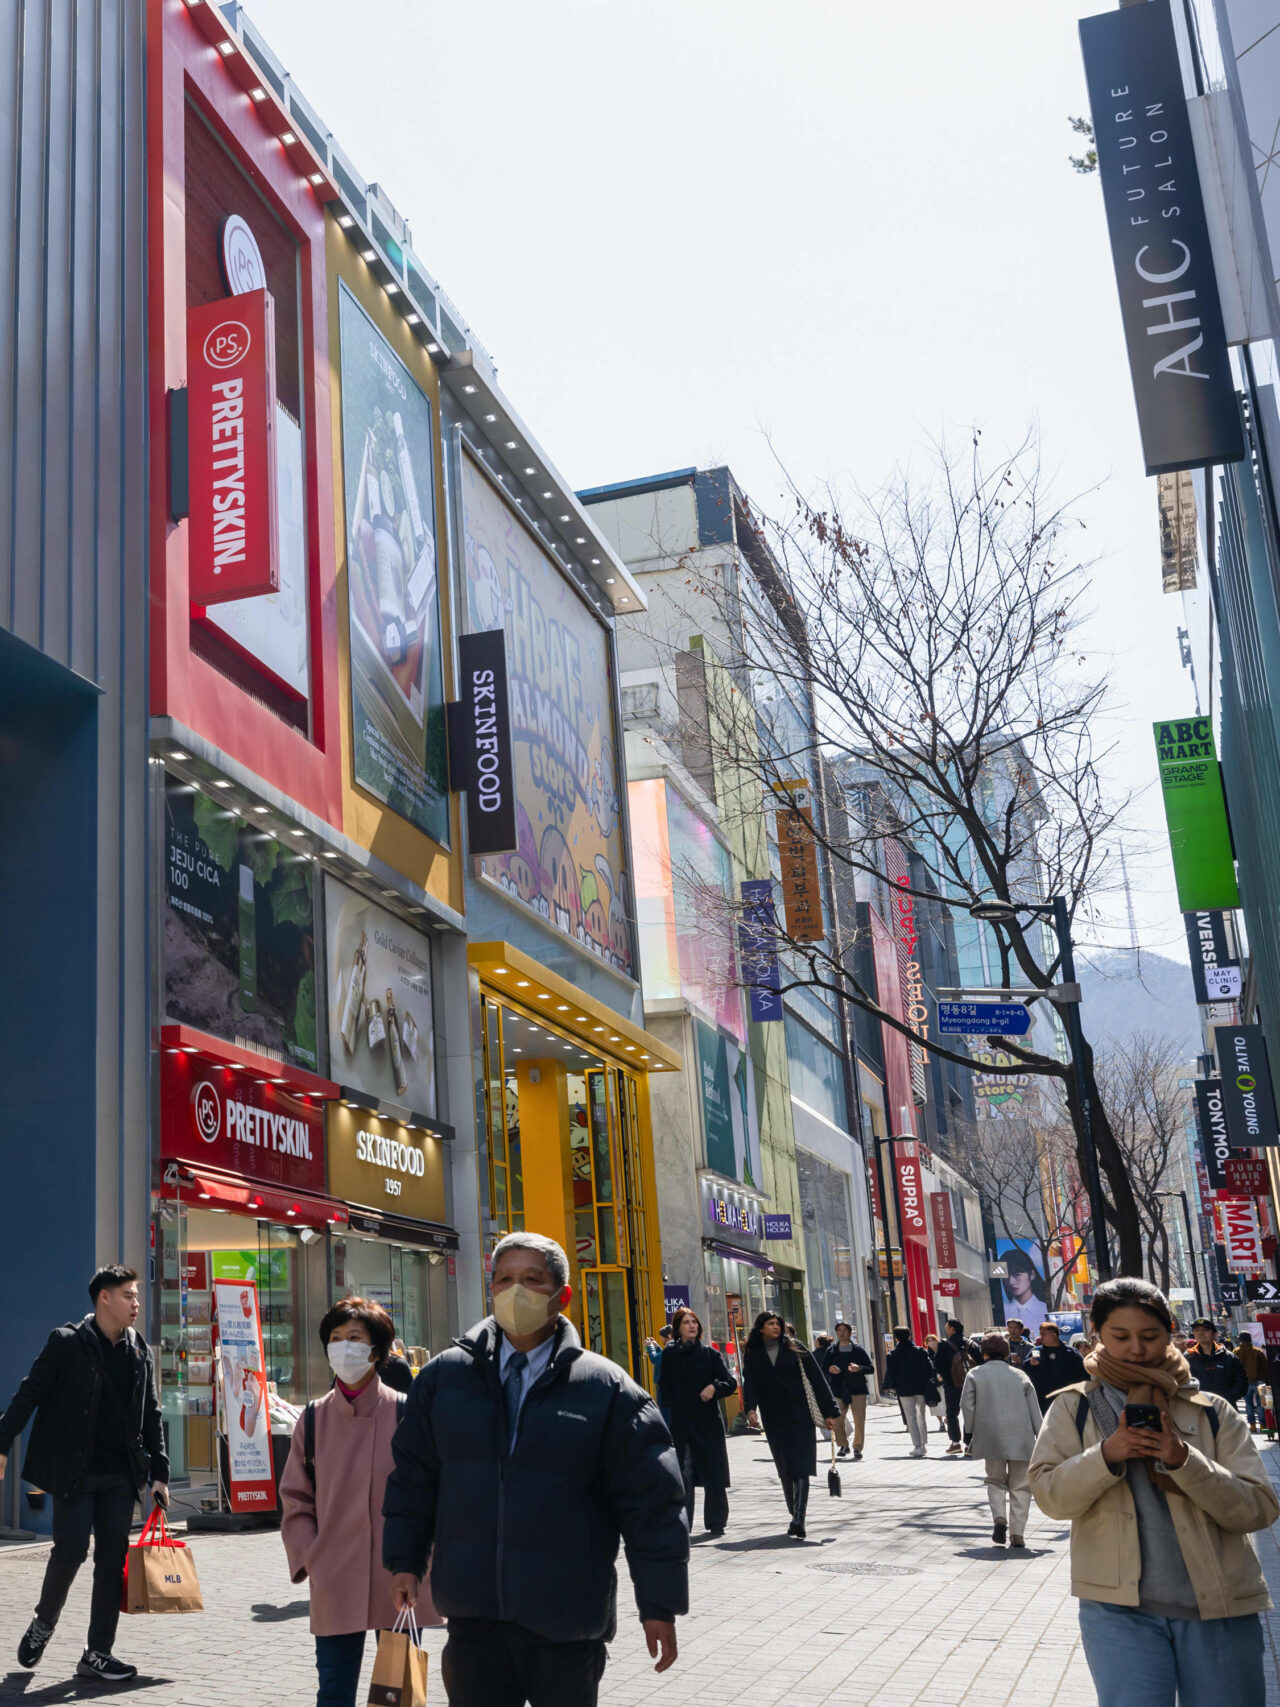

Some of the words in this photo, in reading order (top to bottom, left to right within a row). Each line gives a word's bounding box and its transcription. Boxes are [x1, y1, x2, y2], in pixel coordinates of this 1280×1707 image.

[1111, 85, 1149, 225] FUTURE
[1145, 102, 1180, 217] SALON
[1135, 238, 1210, 379] AHC
[211, 377, 246, 575] PRETTYSKIN.
[473, 669, 501, 812] SKINFOOD
[510, 678, 589, 785] ALMOND
[1158, 719, 1210, 746] ABC
[1159, 741, 1212, 760] MART
[531, 743, 577, 797] store
[1162, 763, 1208, 776] GRAND
[1164, 772, 1205, 784] STAGE
[170, 827, 190, 848] THE
[170, 844, 195, 872] JEJU
[196, 861, 220, 888] CICA
[170, 866, 189, 890] 100
[1208, 976, 1239, 985] CLINIC
[940, 1004, 977, 1016] 명동8길
[941, 1016, 990, 1025] Myeongdong
[991, 1017, 1010, 1026] 8-gil
[1234, 1036, 1250, 1073] OLIVE
[977, 1085, 1015, 1097] store
[1241, 1091, 1260, 1135] YOUNG
[226, 1098, 313, 1161] PRETTYSKIN.
[356, 1129, 425, 1177] SKINFOOD
[1228, 1163, 1263, 1172] JUNO
[1232, 1172, 1261, 1181] HAIR
[384, 1178, 402, 1197] 1957
[900, 1165, 919, 1219] SUPRA
[1225, 1203, 1259, 1264] MART
[1223, 1291, 1237, 1299] VT
[164, 1574, 182, 1584] MLB
